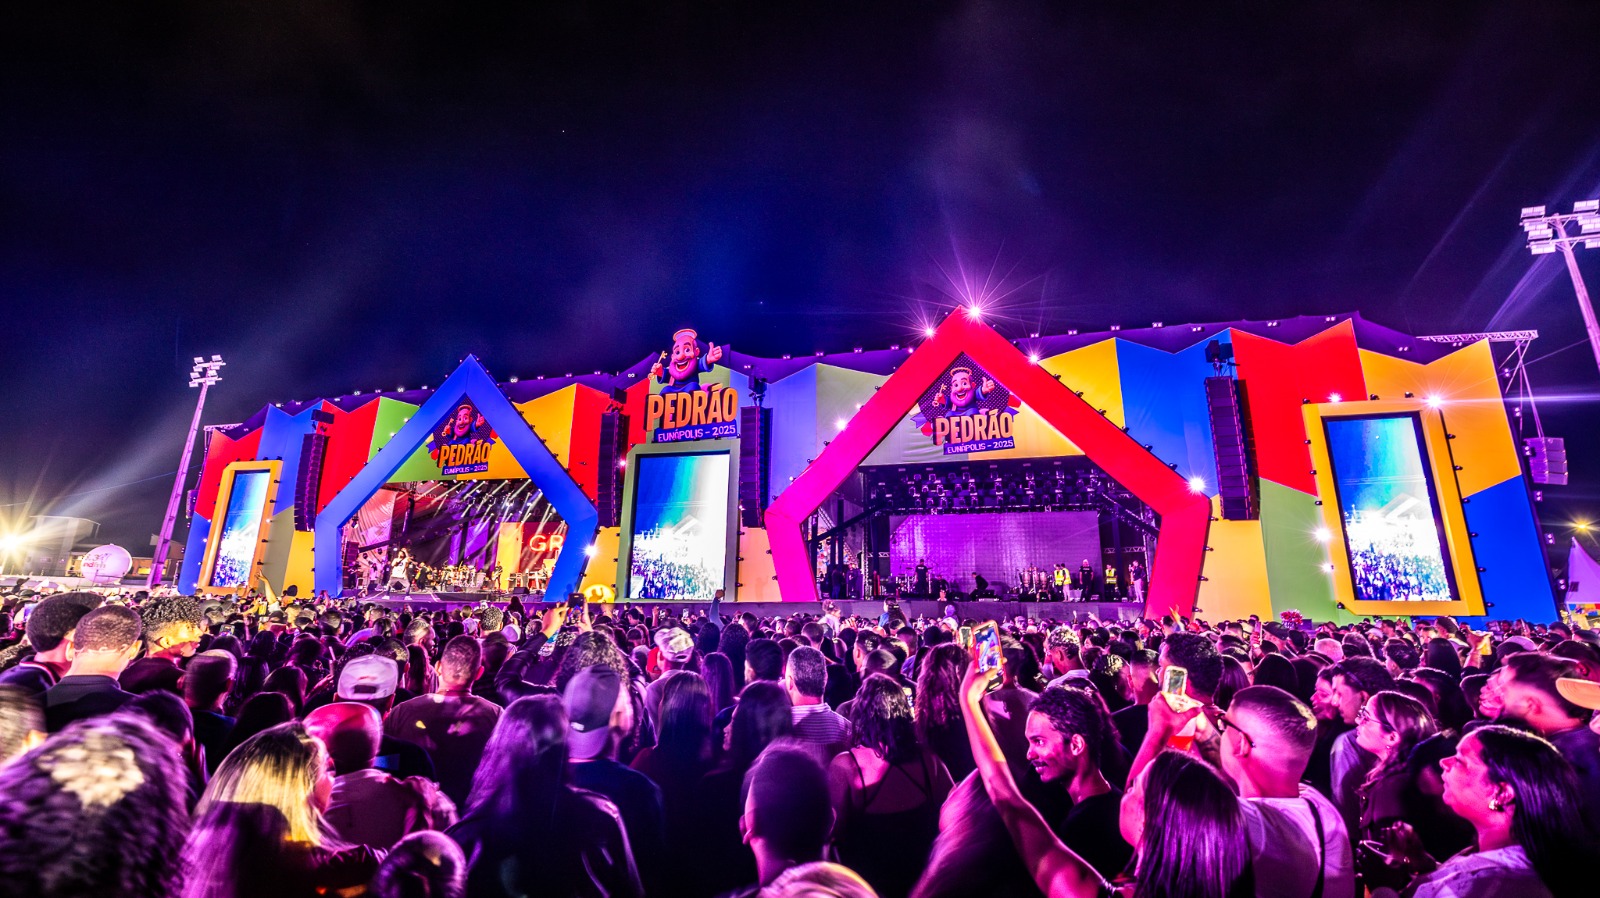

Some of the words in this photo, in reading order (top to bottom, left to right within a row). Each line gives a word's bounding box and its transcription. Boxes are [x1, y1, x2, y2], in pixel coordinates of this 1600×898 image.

[645, 383, 738, 432] PEDRÃO
[657, 429, 704, 442] EUNÁPOLIS
[712, 425, 736, 436] 2025
[934, 409, 1013, 446] PEDRÃO
[438, 440, 491, 468] PEDRÃO
[993, 440, 1014, 449] 2025
